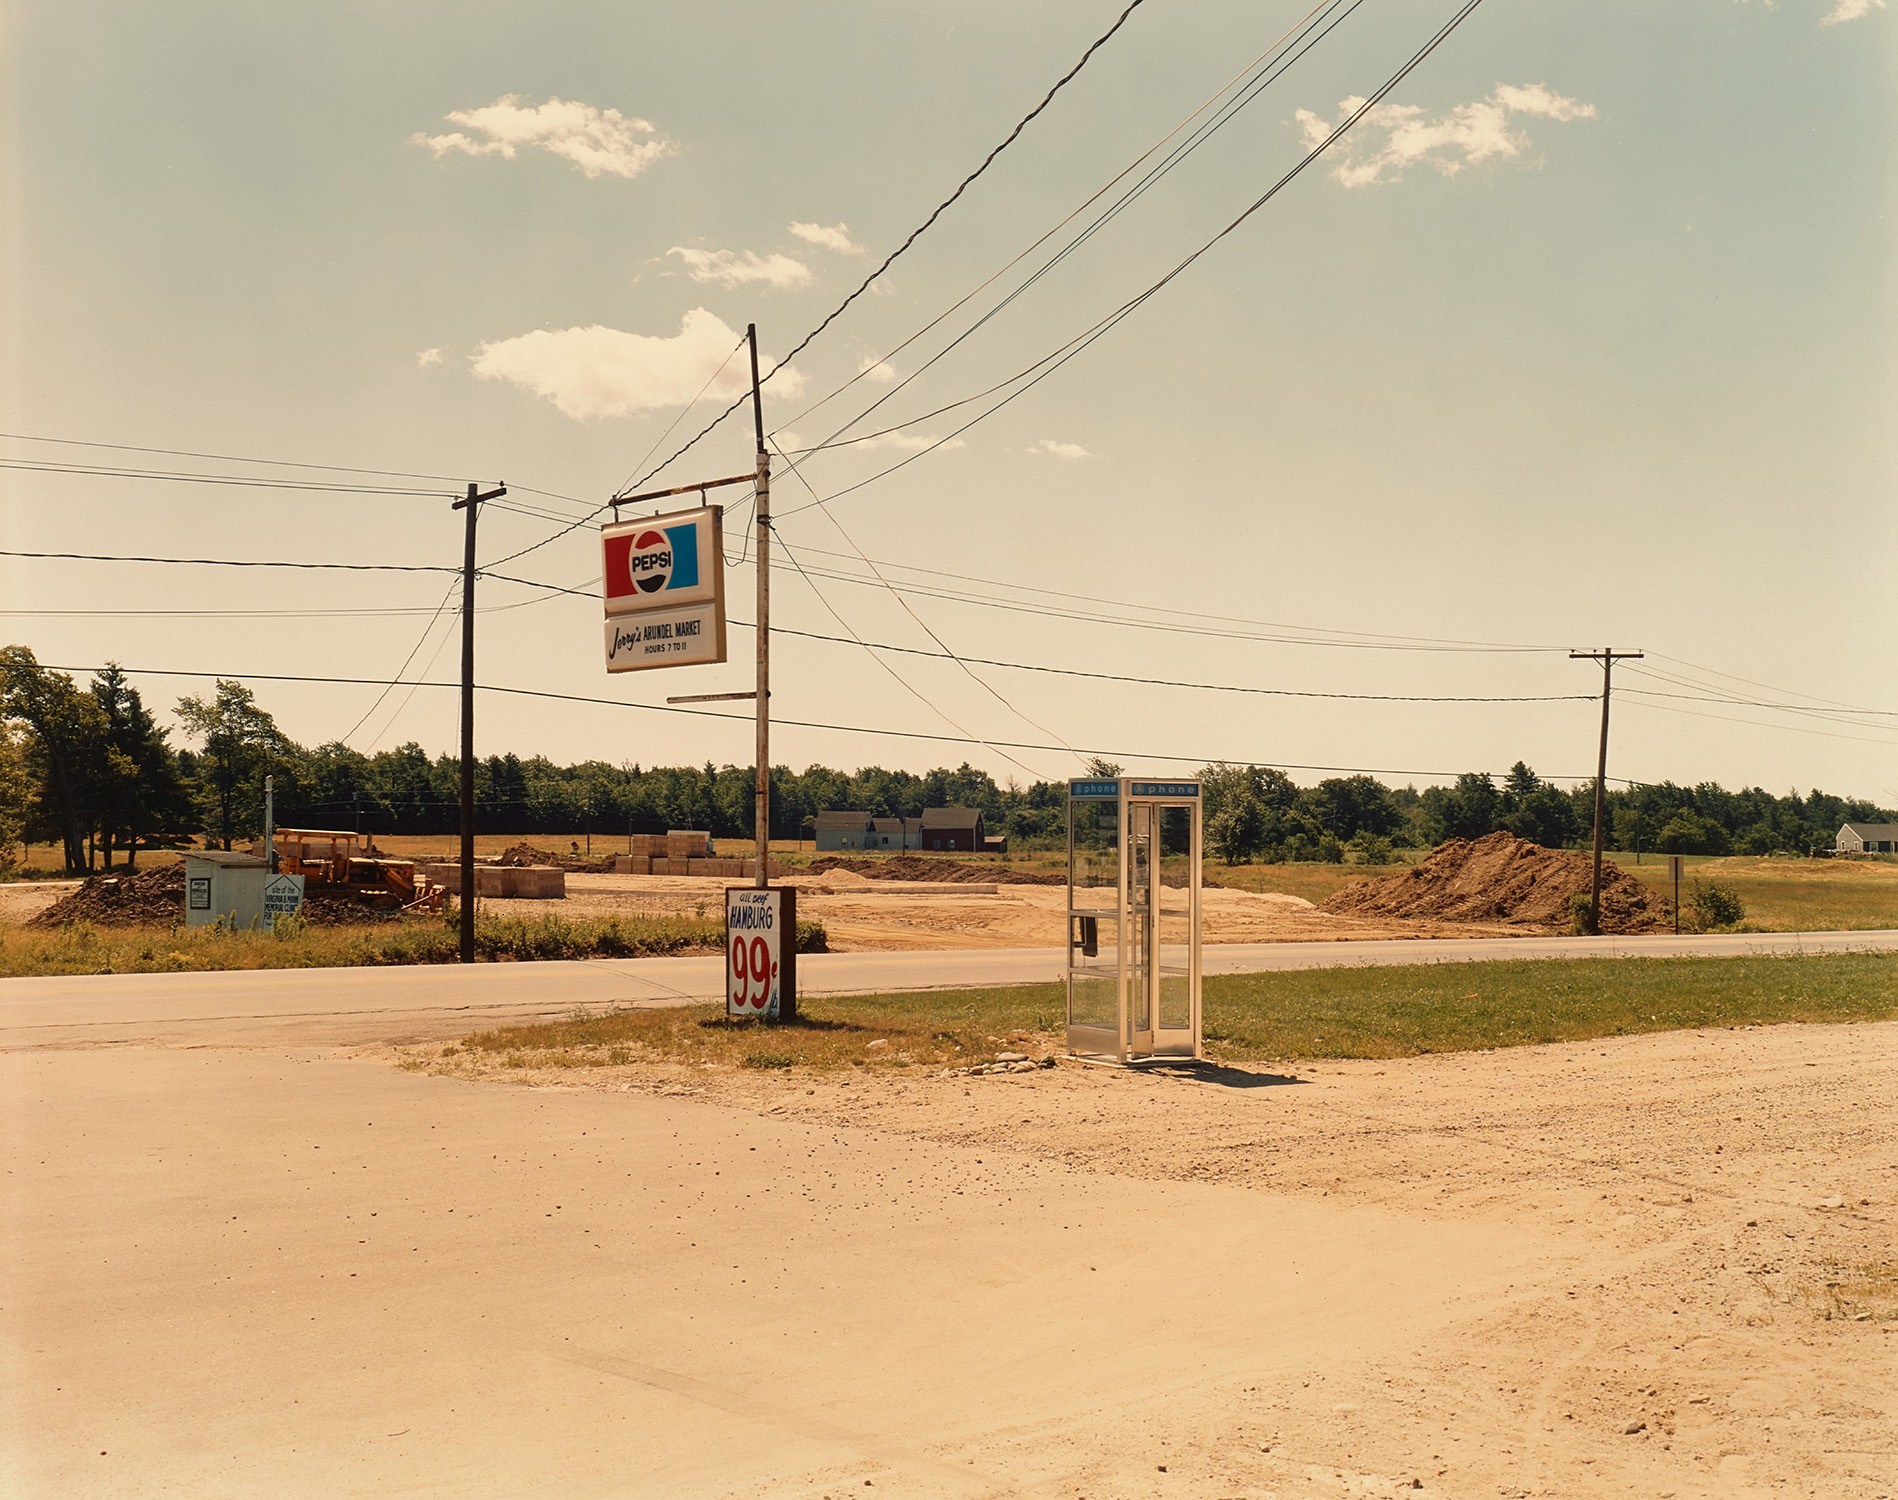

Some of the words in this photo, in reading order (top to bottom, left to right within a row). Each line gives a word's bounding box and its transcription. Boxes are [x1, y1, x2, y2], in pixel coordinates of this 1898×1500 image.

[632, 551, 671, 572] PEPSI
[609, 626, 641, 660] Jerry's
[643, 623, 674, 641] ARUNDEL
[675, 620, 701, 637] MARKET
[644, 643, 666, 654] HOURS
[667, 643, 672, 652] 7
[673, 642, 681, 651] TO
[681, 641, 687, 650] 11
[1084, 784, 1116, 793] phone
[1149, 784, 1194, 794] phone
[271, 885, 281, 894] site
[281, 885, 287, 894] of
[287, 886, 296, 894] the
[739, 892, 751, 903] all
[265, 903, 284, 912] MEMORIAL
[730, 905, 773, 930] HAMBURG
